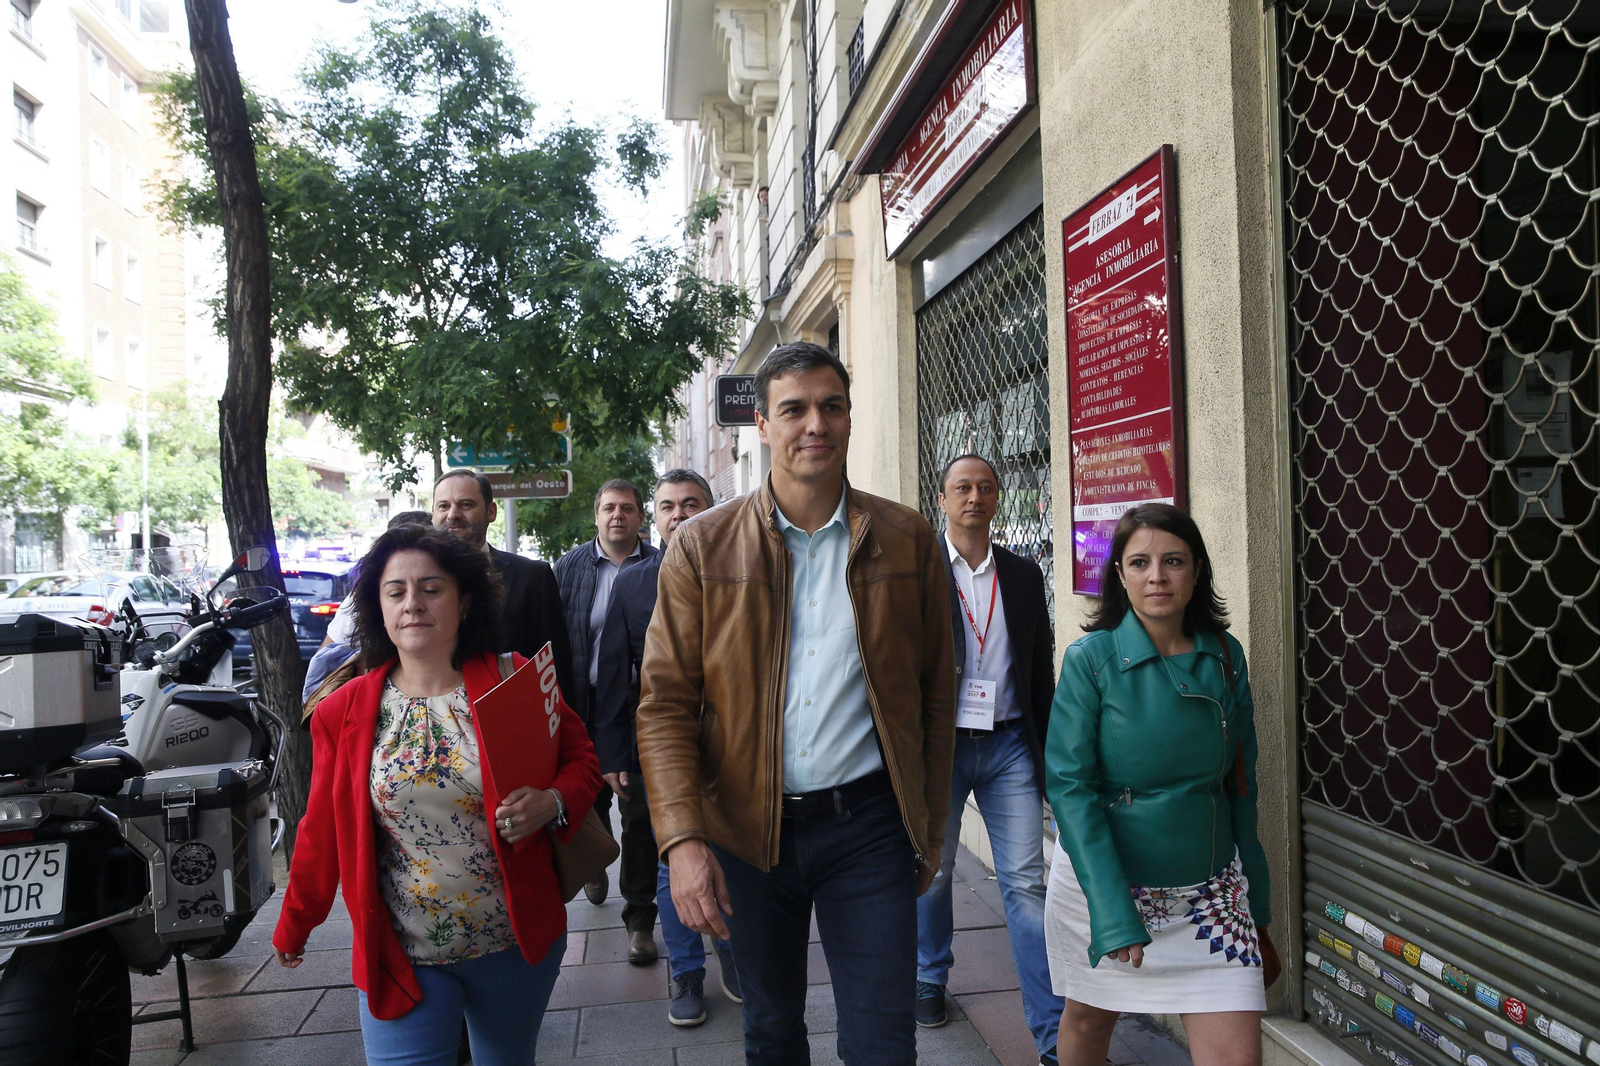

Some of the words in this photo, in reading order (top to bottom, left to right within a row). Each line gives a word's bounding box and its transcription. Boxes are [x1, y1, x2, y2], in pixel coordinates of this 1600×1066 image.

[920, 96, 949, 147] AGENCIA
[951, 1, 1019, 103] INMOBILIARIA
[1091, 202, 1123, 237] FERRAZ
[1126, 193, 1135, 214] 74
[1095, 237, 1132, 269] ASESORIA
[1072, 272, 1102, 297] AGENCIA
[1105, 238, 1159, 279] INMOBILIARIA
[1102, 304, 1110, 315] DE
[1110, 290, 1138, 310] EMPRESAS
[1077, 318, 1110, 340] CONSTITUCION
[1109, 315, 1117, 324] DE
[1116, 301, 1147, 320] SOCIEDADES
[1078, 335, 1106, 353] PROYECTOS
[1106, 331, 1114, 342] DE
[1115, 318, 1143, 338] EMPRESAS
[1078, 347, 1110, 367] DECLARACION
[1110, 343, 1117, 354] DE
[1117, 332, 1145, 351] IMPUESTOS
[1100, 356, 1122, 373] SEGUROS
[1124, 346, 1149, 363] SOCIALES
[736, 380, 755, 392] UÑ
[1080, 375, 1109, 393] CONTRATOS
[1113, 363, 1144, 382] HERENCIAS
[1080, 385, 1122, 407] CONTABILIDADES
[1108, 396, 1137, 412] LABORALES
[1111, 426, 1153, 444] INMOBILIARIAS
[1101, 453, 1108, 462] DE
[1108, 449, 1132, 461] CREDITOS
[1132, 440, 1171, 457] HIPOTECARIOS
[536, 479, 566, 489] Oeste
[1083, 470, 1107, 481] ESTUDIOS
[1107, 468, 1115, 477] DE
[1115, 464, 1142, 476] MERCADO
[1084, 483, 1126, 497] ADMINISTRACION
[1127, 481, 1135, 491] DE
[1136, 479, 1157, 491] FINCAS
[1082, 507, 1104, 517] COMPRA
[1084, 543, 1105, 553] LOCALES
[534, 640, 561, 739] PSOE
[1, 848, 61, 882] 075
[0, 882, 44, 915] DR
